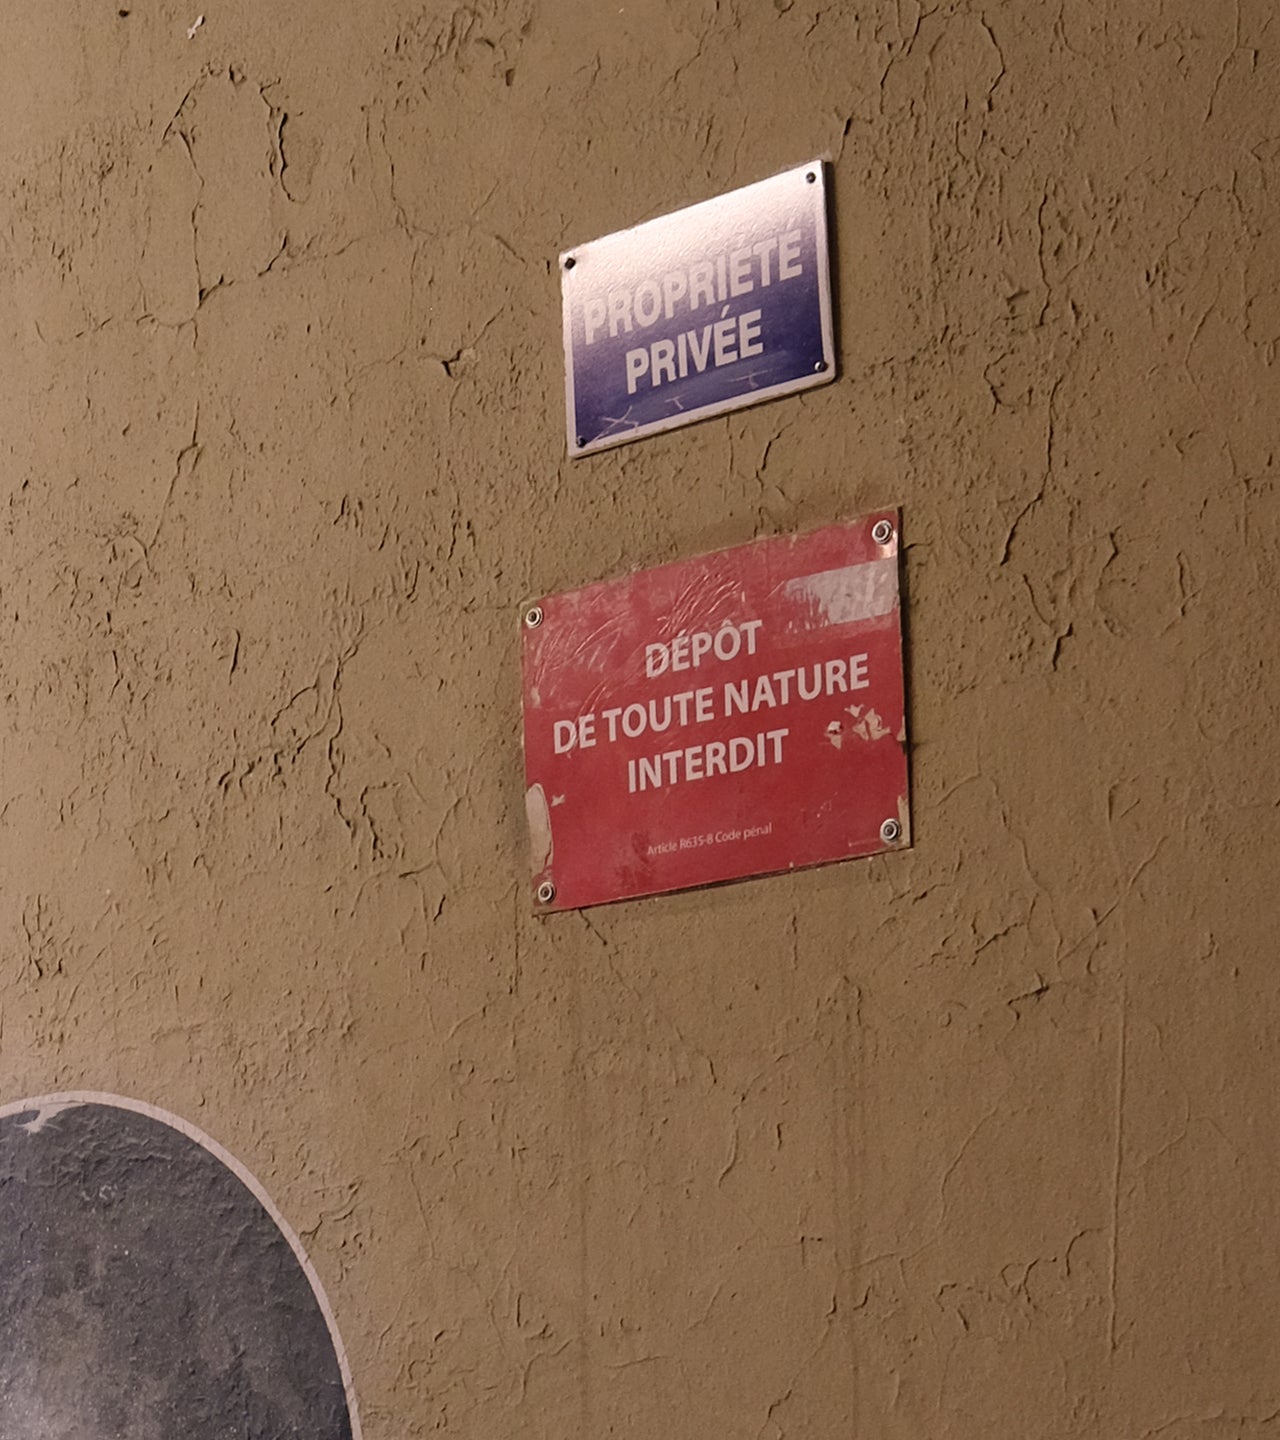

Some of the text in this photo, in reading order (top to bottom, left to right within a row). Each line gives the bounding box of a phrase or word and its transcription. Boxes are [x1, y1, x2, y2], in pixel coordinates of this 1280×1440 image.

[625, 304, 764, 395] PRIVÉE
[645, 619, 763, 678] DÉPÔT
[553, 652, 870, 754] DE TOUTE NATURE
[628, 728, 789, 794] INTERDIT
[646, 841, 678, 856] Article
[715, 829, 742, 843] Code
[743, 822, 773, 841] pénal
